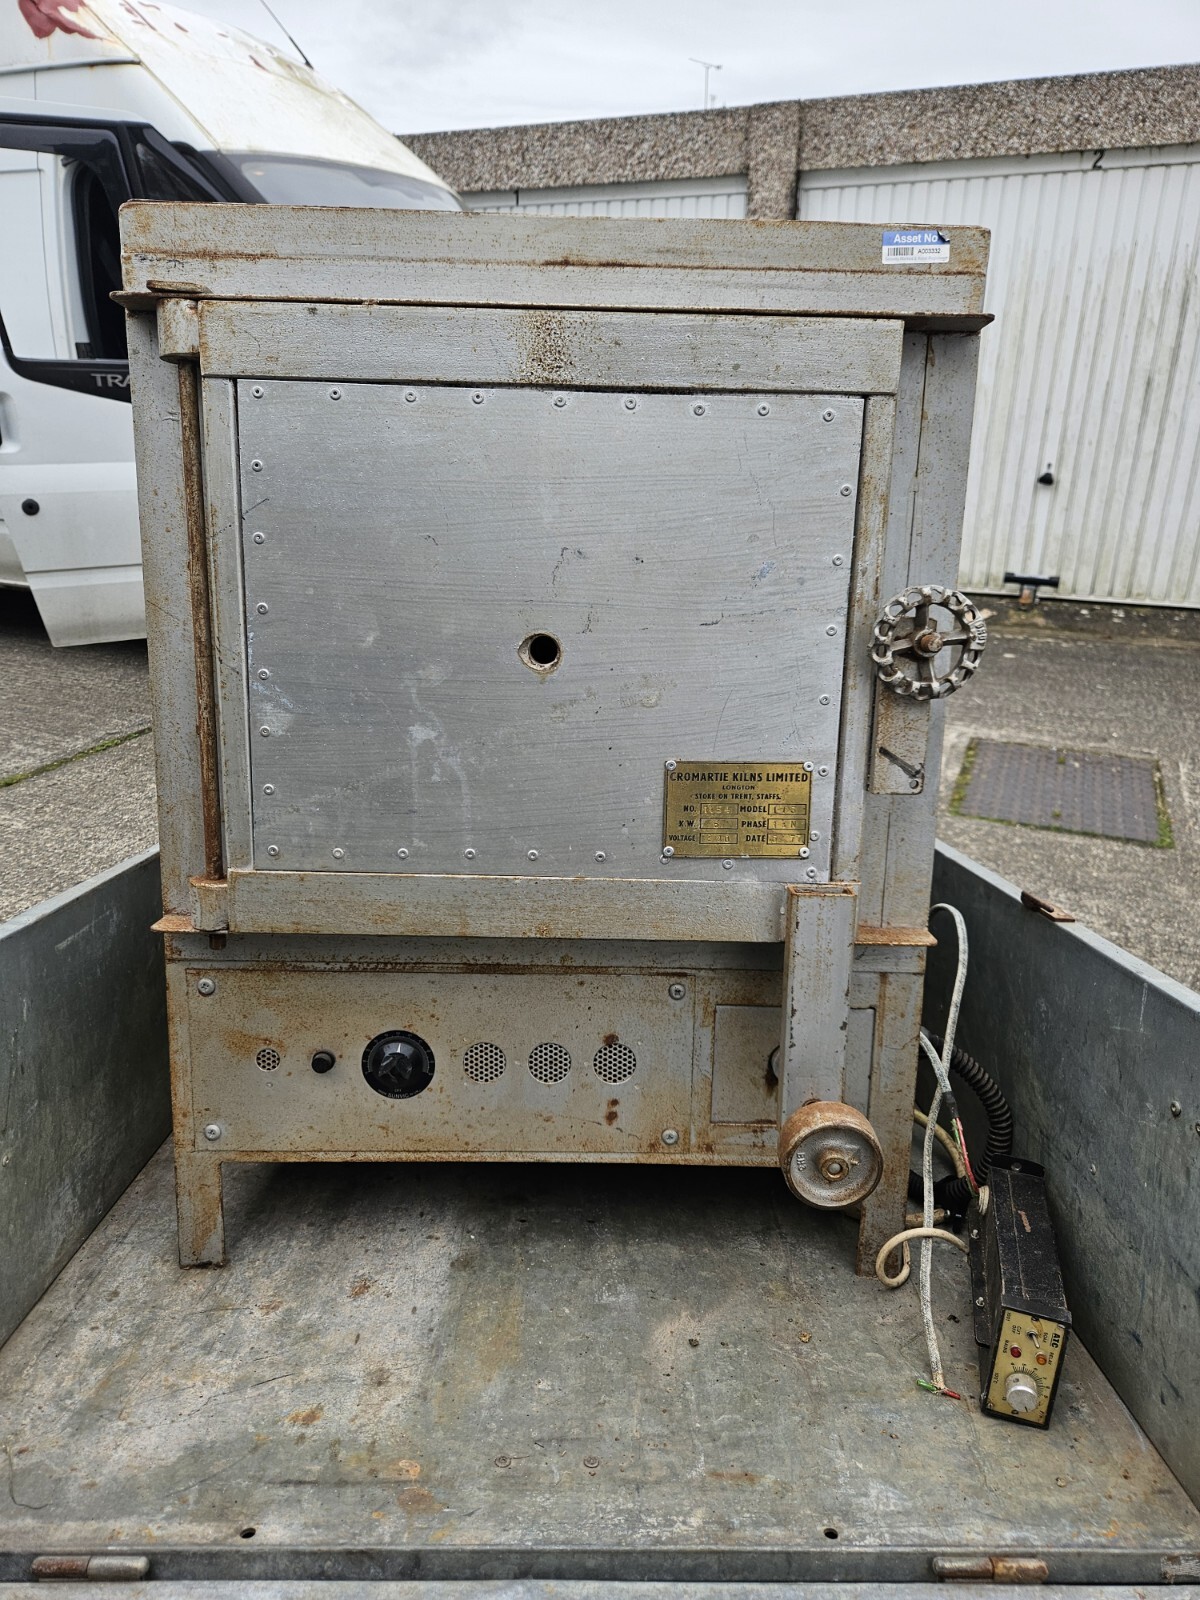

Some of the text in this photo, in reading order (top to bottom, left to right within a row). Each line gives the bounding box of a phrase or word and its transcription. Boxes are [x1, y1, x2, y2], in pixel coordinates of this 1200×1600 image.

[1093, 149, 1105, 170] 2
[894, 233, 938, 243] Asset No
[670, 772, 808, 782] CROMARTIE KILNS LIMITED
[740, 805, 767, 813] MODEL
[741, 820, 767, 828] PHASE
[745, 834, 766, 842] DATE
[1051, 1333, 1061, 1349] ATC
